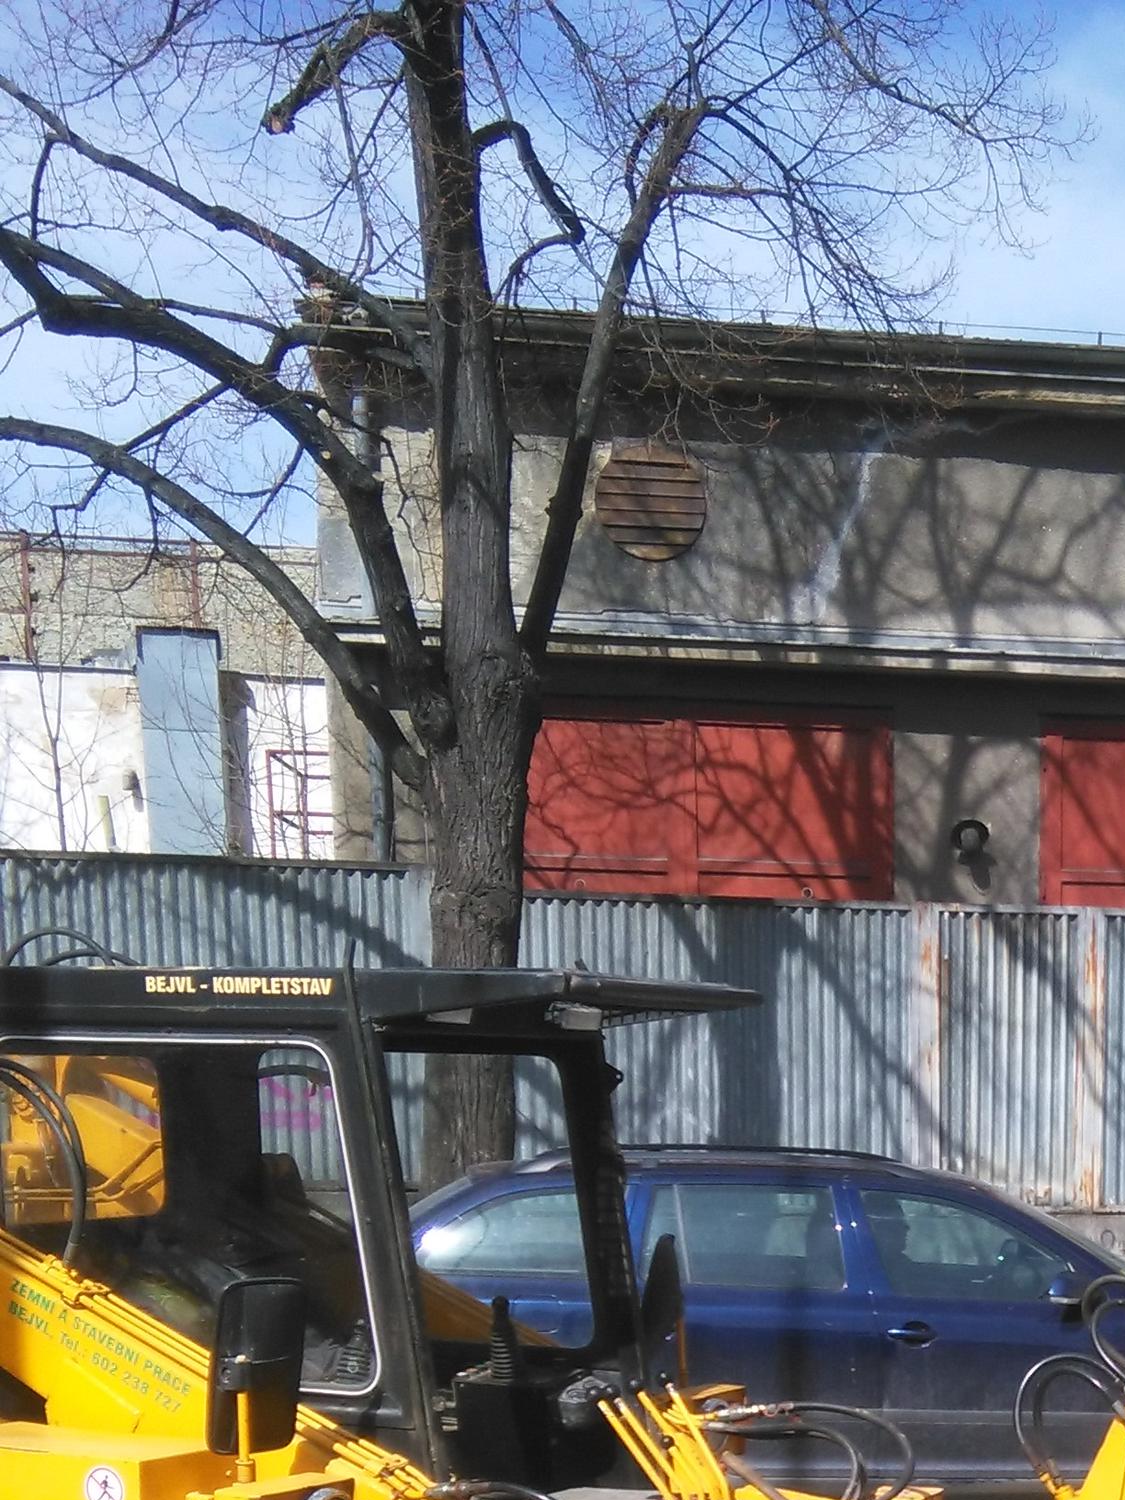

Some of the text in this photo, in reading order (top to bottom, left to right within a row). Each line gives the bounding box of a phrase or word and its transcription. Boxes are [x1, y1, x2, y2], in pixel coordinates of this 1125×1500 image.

[145, 976, 196, 993] BEJVL
[212, 976, 332, 995] KOMPLETSTAV
[91, 1352, 118, 1376] 602
[122, 1371, 150, 1395] 238
[154, 1389, 182, 1413] 727
